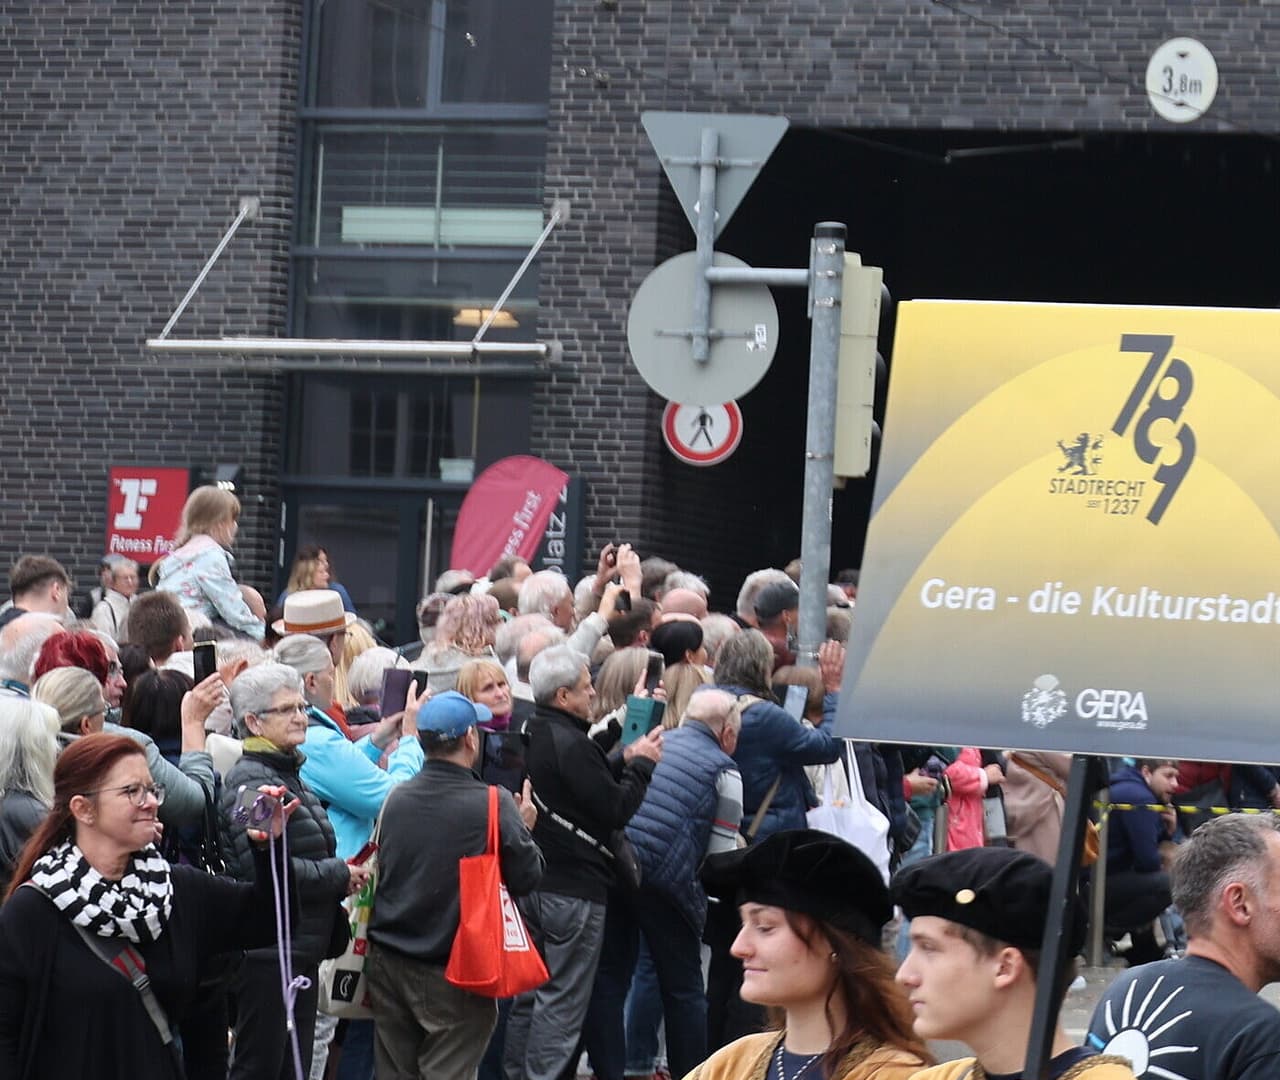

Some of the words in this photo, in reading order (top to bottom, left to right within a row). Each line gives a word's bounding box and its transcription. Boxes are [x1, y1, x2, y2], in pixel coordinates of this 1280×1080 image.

[1048, 477, 1147, 498] STADTRECHT
[1103, 498, 1140, 516] 1237
[920, 578, 997, 611] Gera
[1028, 581, 1081, 615] die
[1075, 688, 1149, 721] GERA
